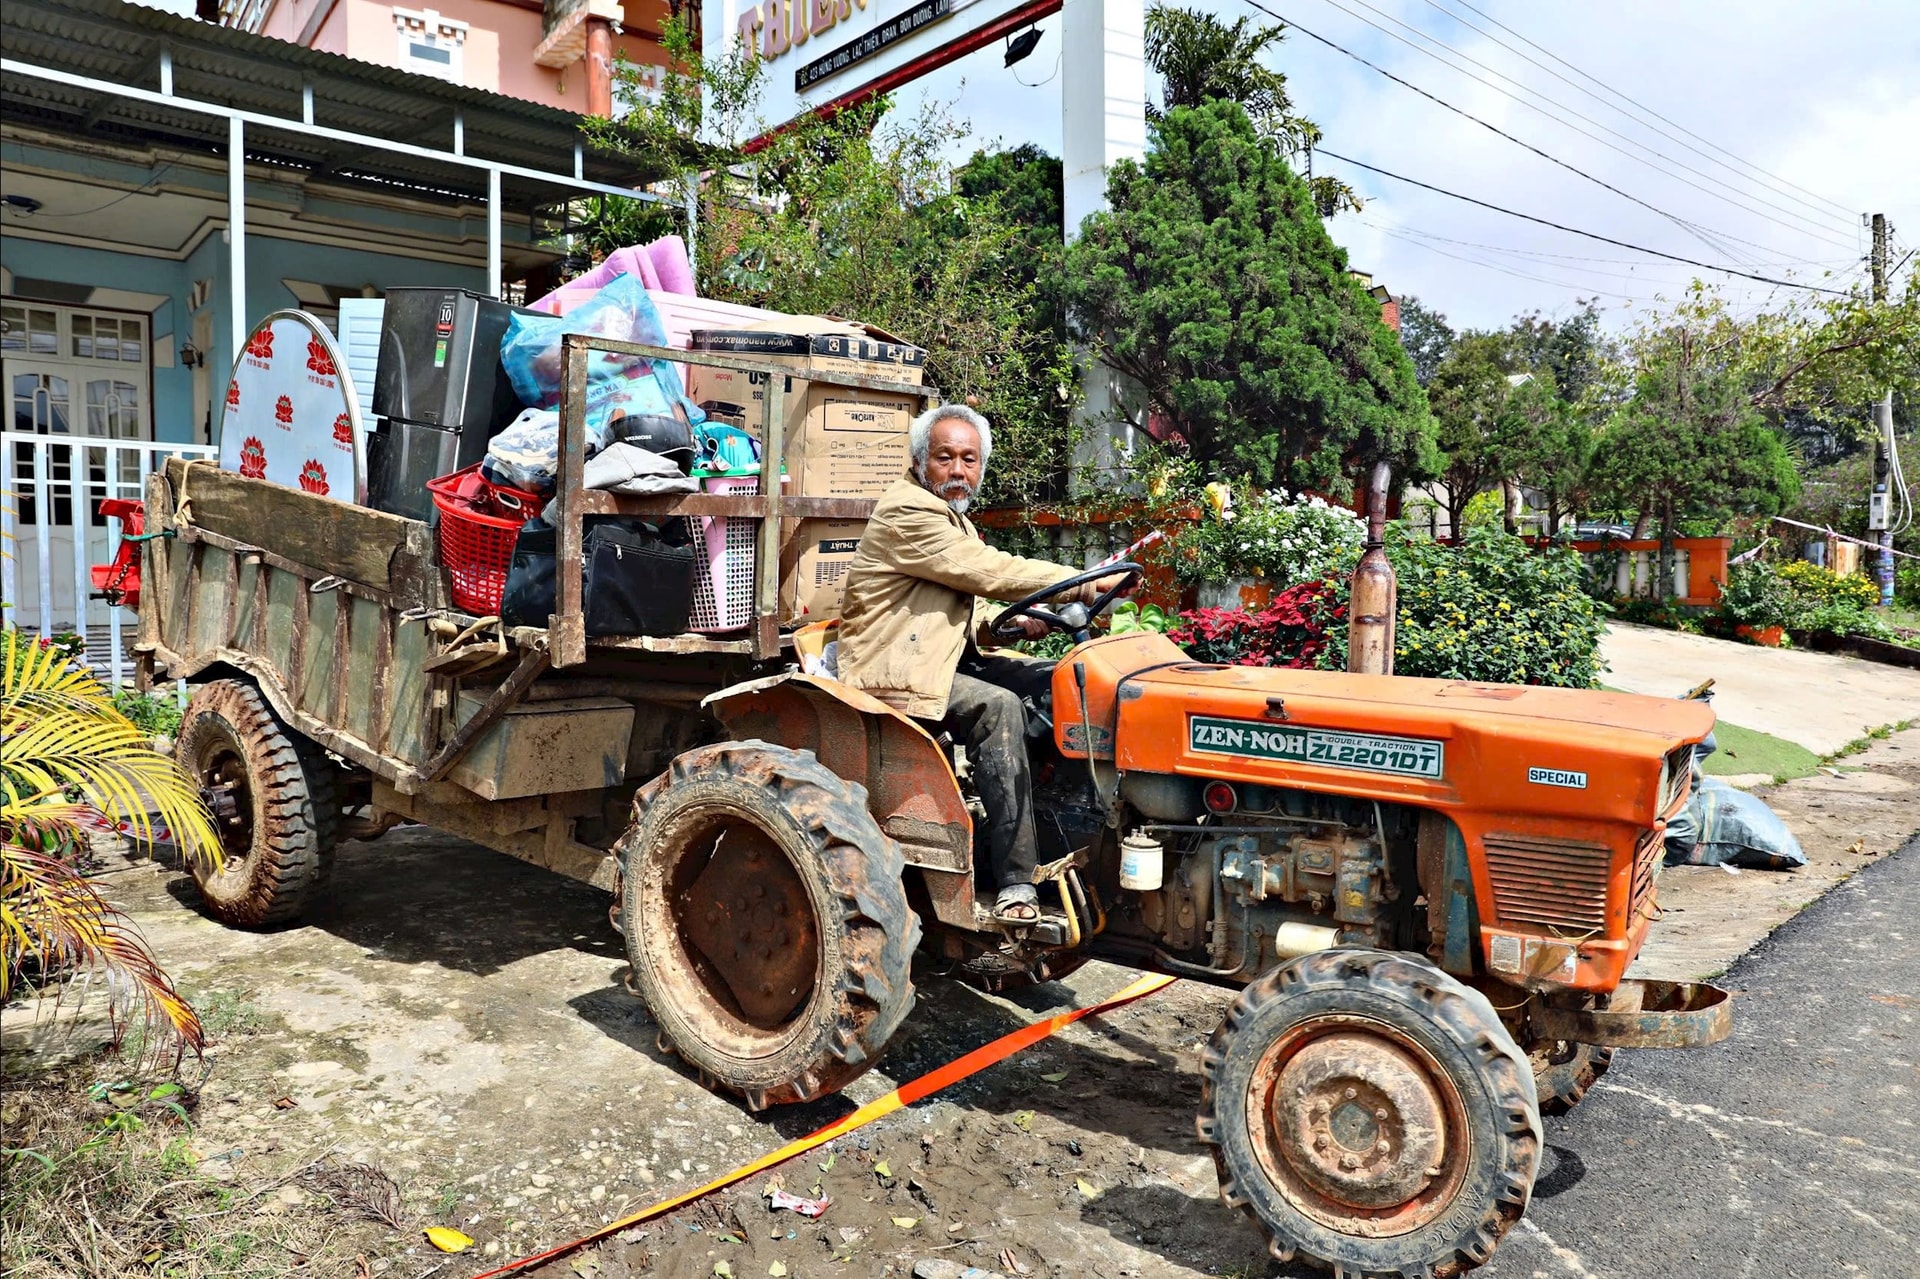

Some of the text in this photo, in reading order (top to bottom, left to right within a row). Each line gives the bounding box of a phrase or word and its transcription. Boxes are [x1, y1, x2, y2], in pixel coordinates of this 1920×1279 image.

[441, 308, 452, 322] 10
[624, 434, 653, 442] HONDA
[1194, 724, 1436, 772] ZEN-NOH ZL2201DT
[1328, 736, 1416, 751] DOUBLE TRACTION
[1530, 770, 1585, 787] SPECIAL
